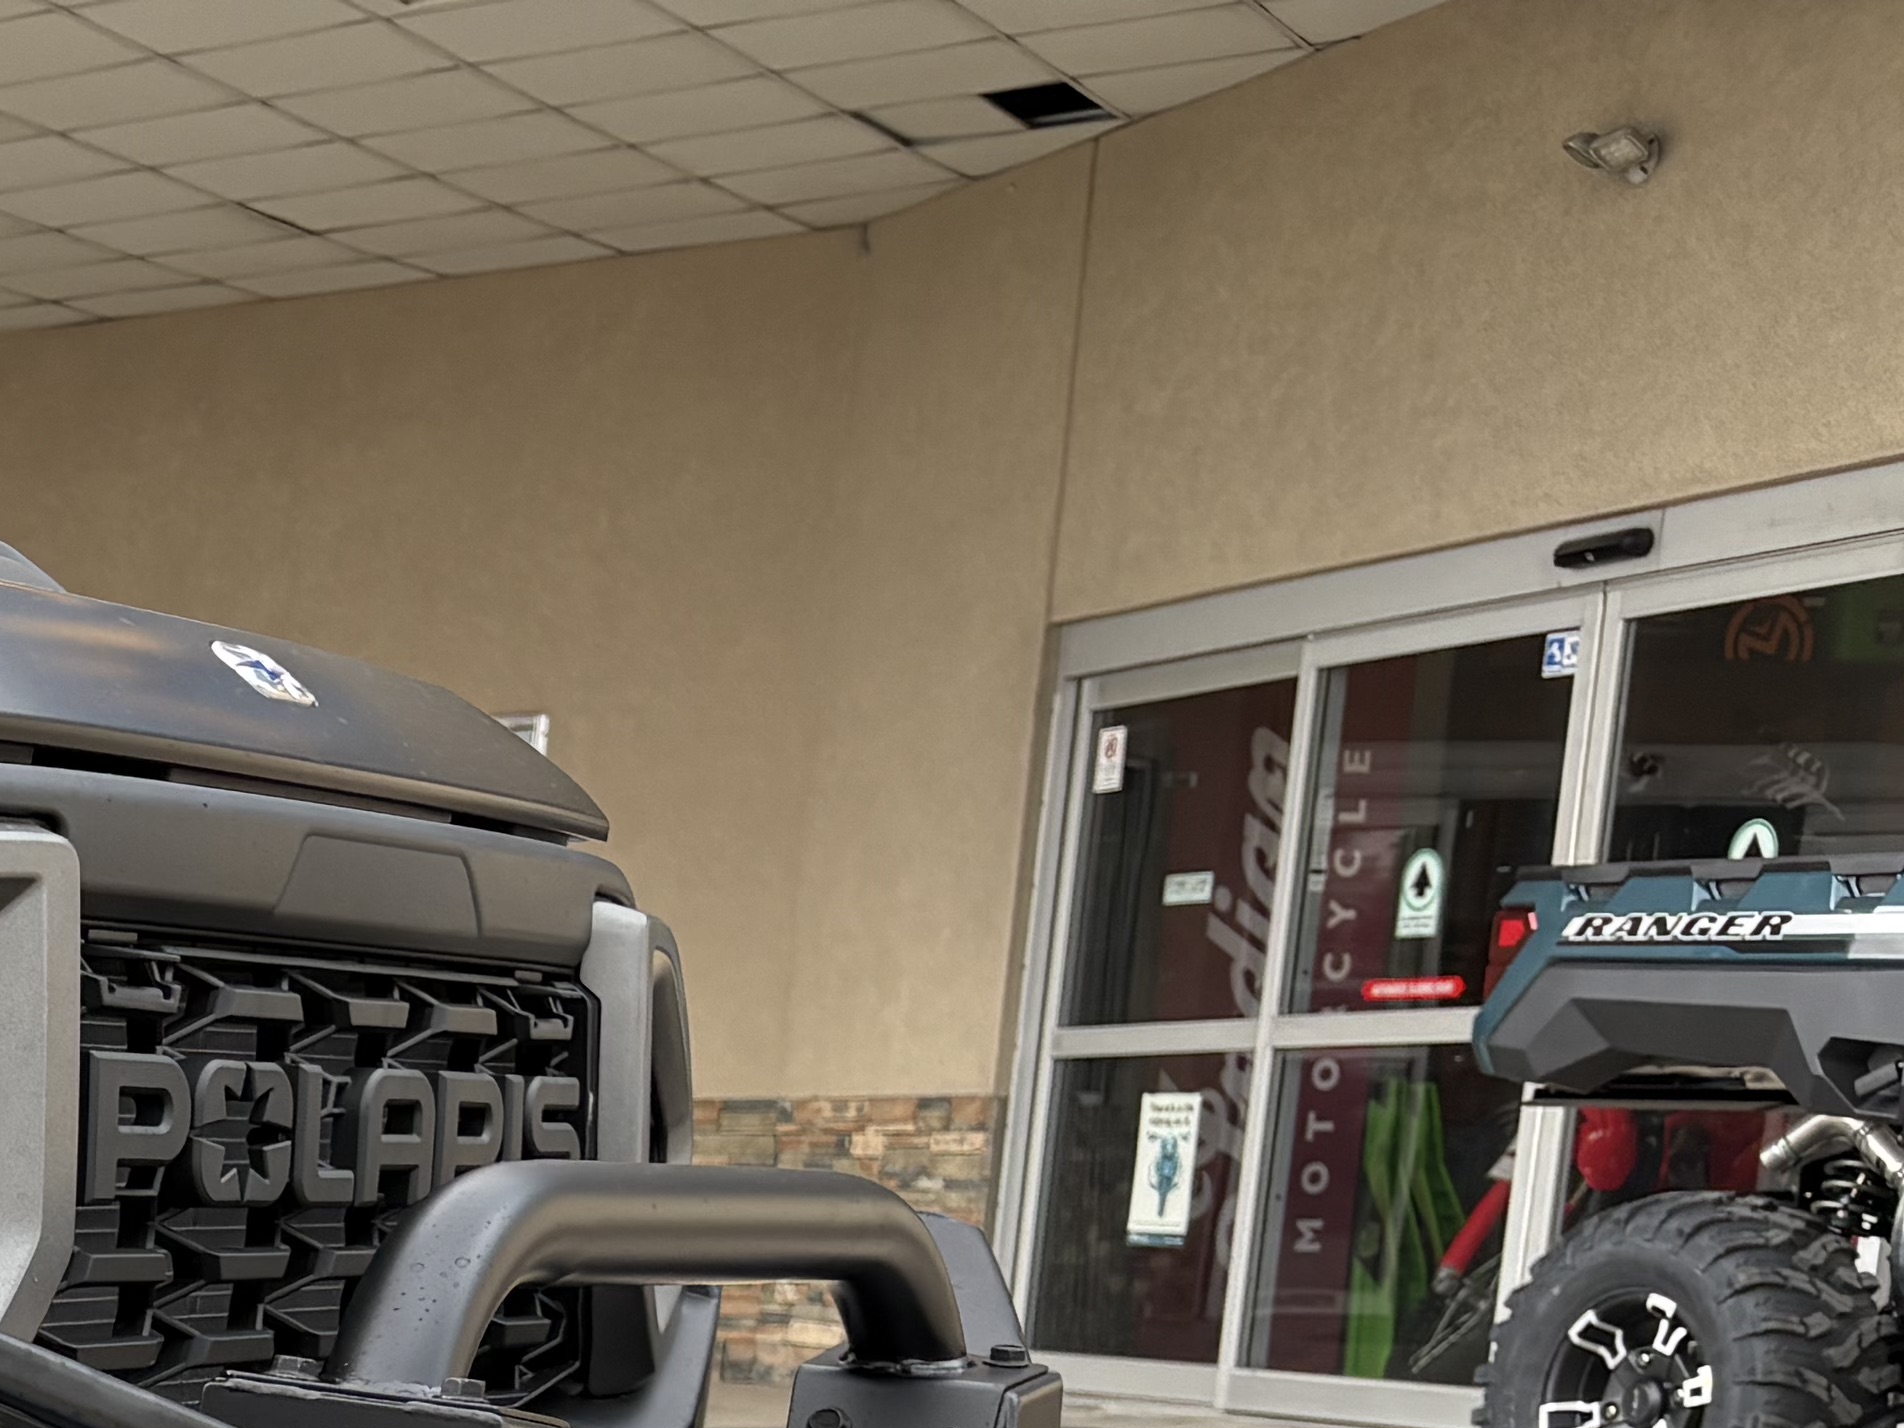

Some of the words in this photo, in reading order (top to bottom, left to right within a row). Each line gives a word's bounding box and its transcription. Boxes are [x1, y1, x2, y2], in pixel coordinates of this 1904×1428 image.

[1294, 747, 1373, 1256] MOTOCYCLE
[1572, 912, 1793, 941] RANGER
[82, 1048, 582, 1206] POLARIS
